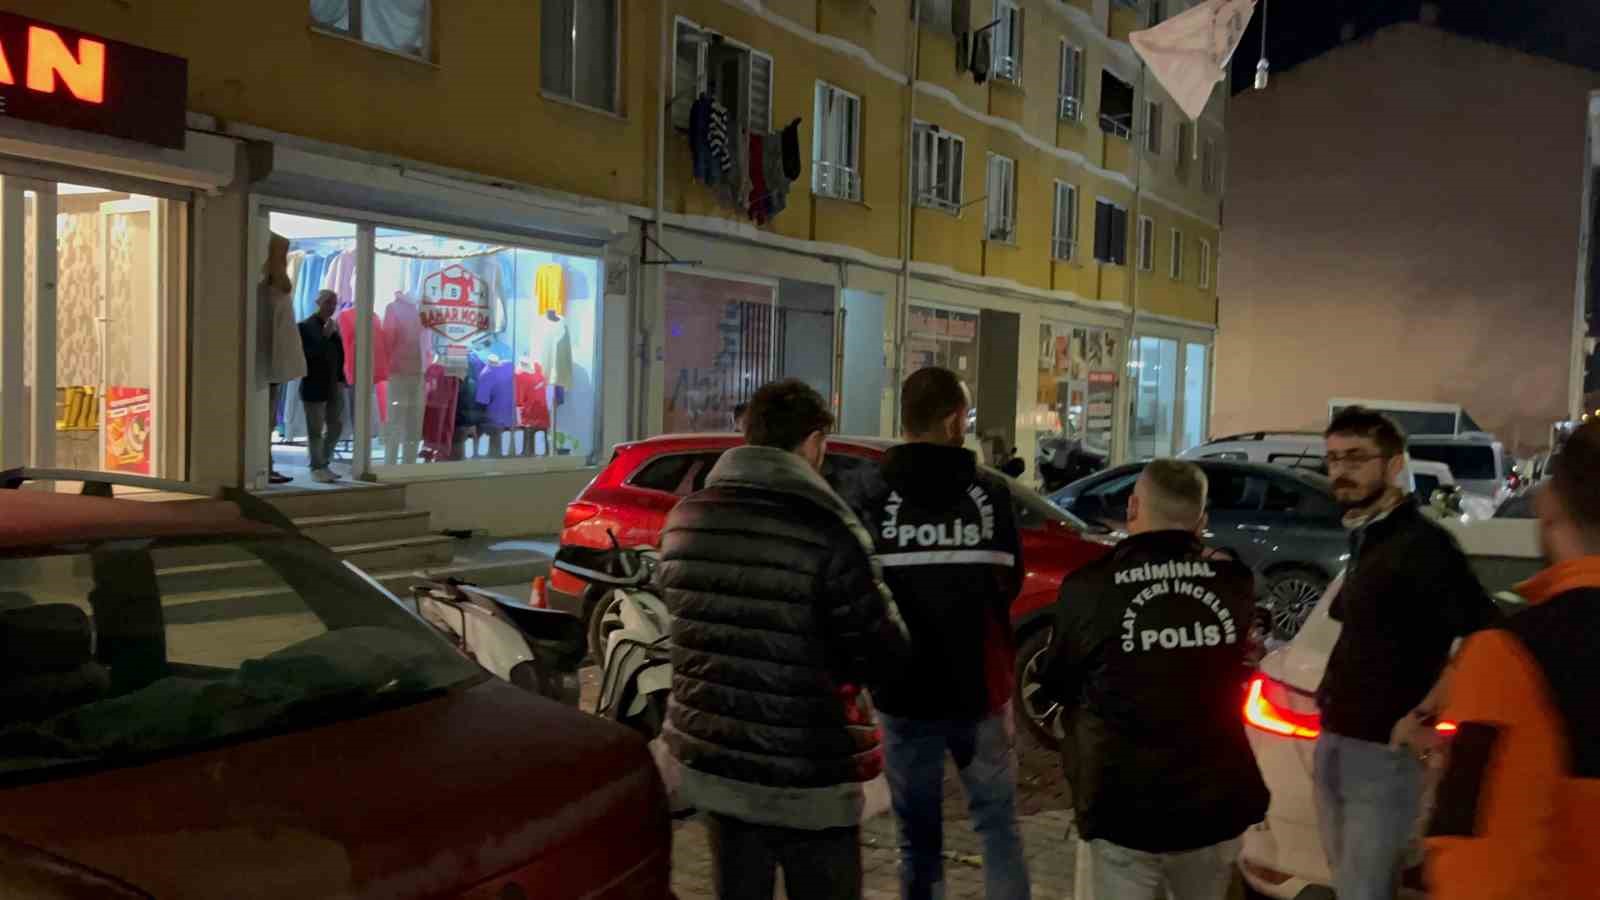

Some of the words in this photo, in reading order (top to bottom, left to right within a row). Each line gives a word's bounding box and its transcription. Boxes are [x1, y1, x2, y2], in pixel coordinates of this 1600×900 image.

[0, 25, 105, 104] N
[898, 517, 980, 547] POLİS
[1114, 560, 1217, 584] KRİMİNAL
[1120, 606, 1137, 653] OLAY
[1140, 620, 1222, 651] POLİS
